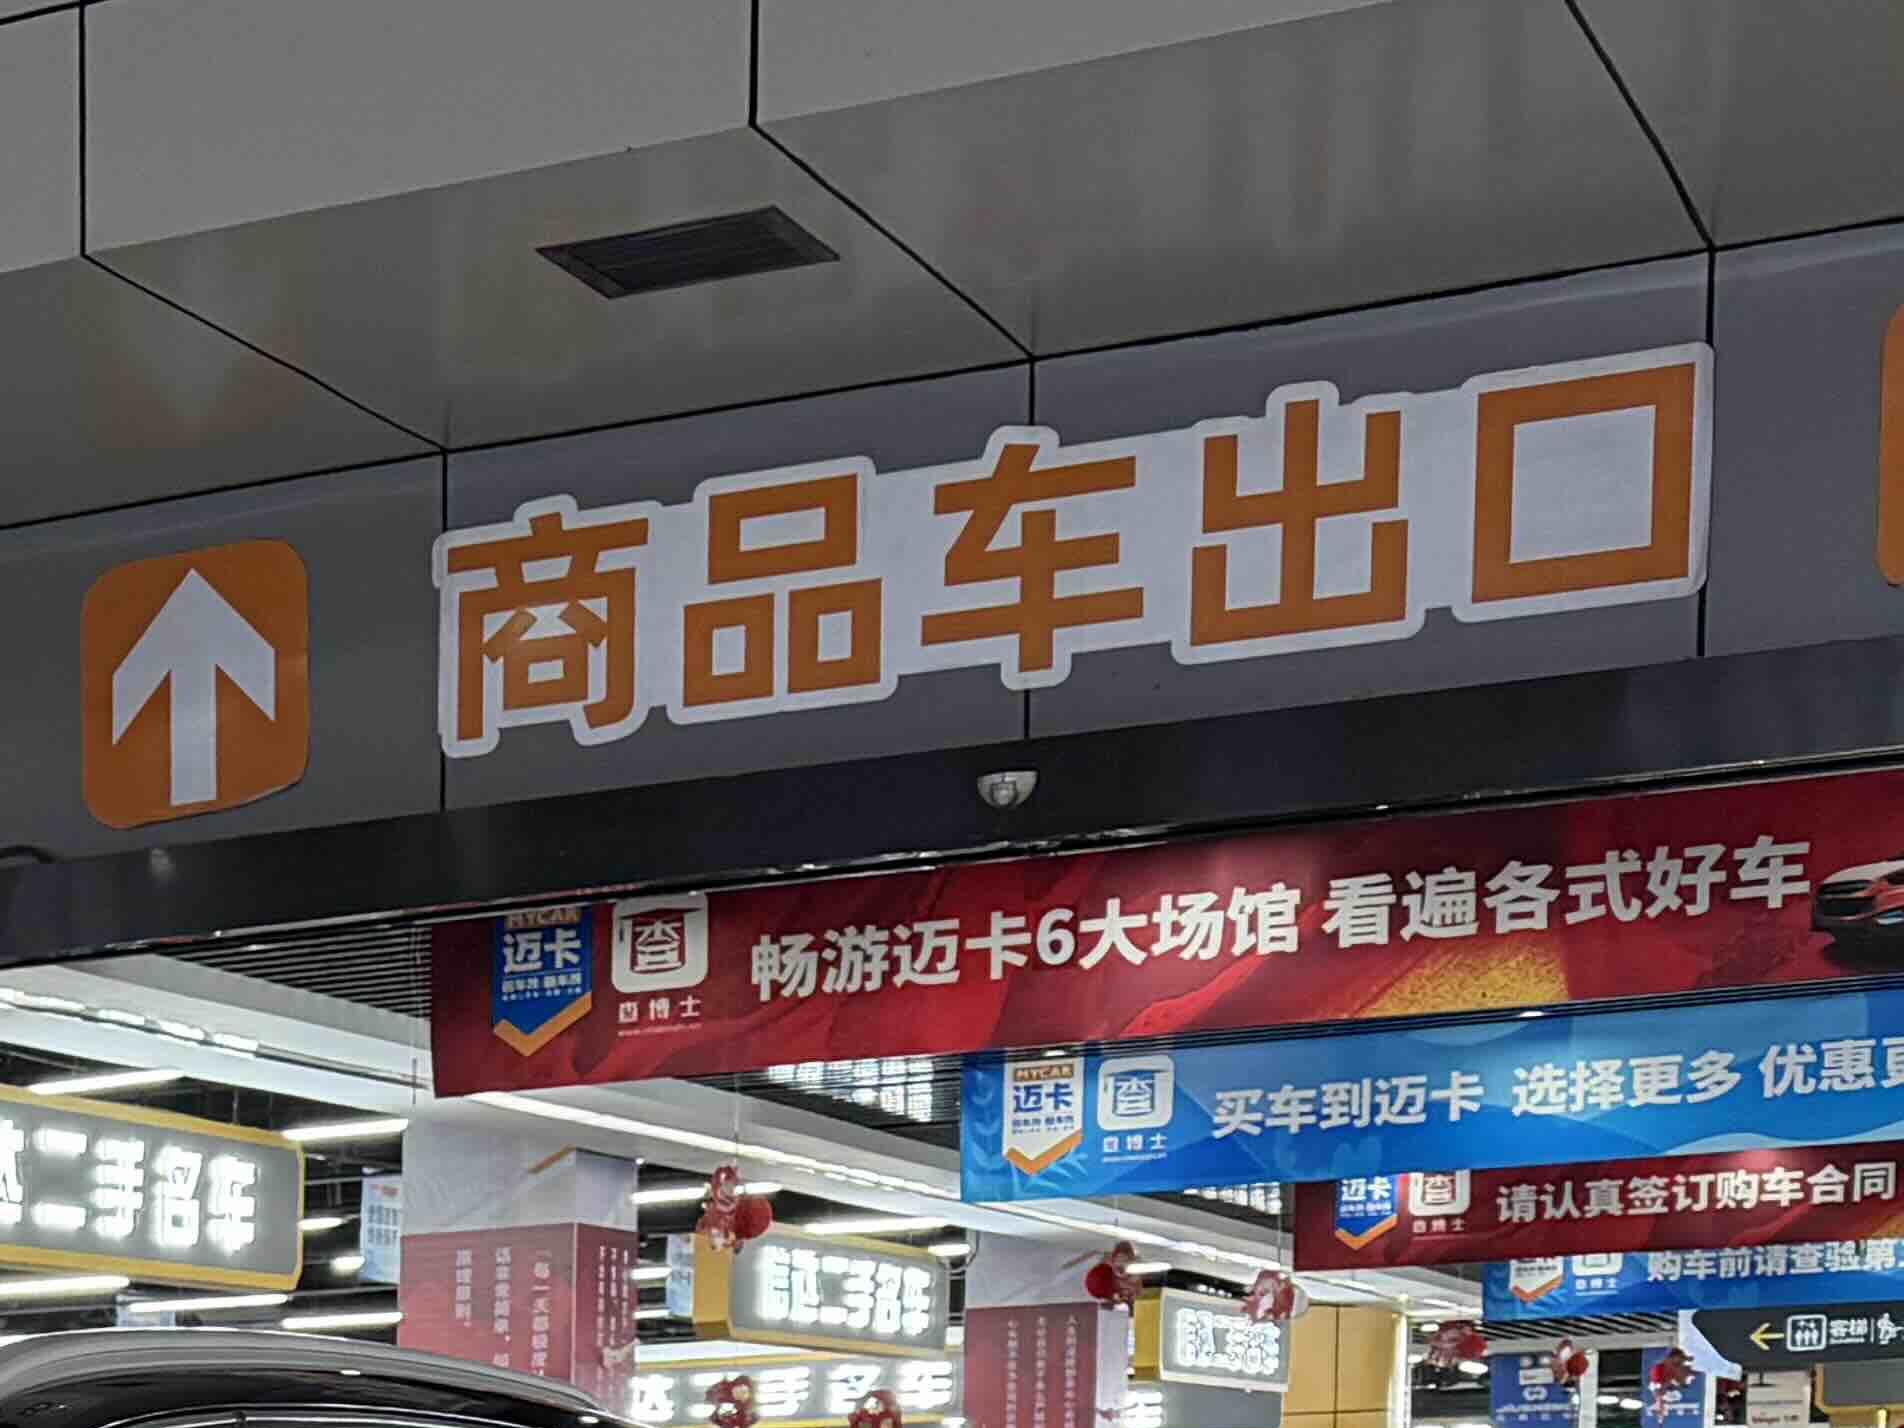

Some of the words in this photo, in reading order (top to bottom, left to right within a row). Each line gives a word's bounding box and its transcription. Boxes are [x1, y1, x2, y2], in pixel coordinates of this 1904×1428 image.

[442, 357, 1699, 742] 商品车出口
[502, 927, 582, 974] 迈卡
[750, 880, 1301, 1001] 畅游迈卡6大场馆
[1322, 835, 1813, 950] 看遍各式好车
[1012, 1082, 1074, 1114] 迈卡
[1211, 1071, 1485, 1140] 买车到迈卡
[1510, 1048, 1743, 1118] 选择更多
[1497, 1161, 1898, 1223] 请认真签订购车合同
